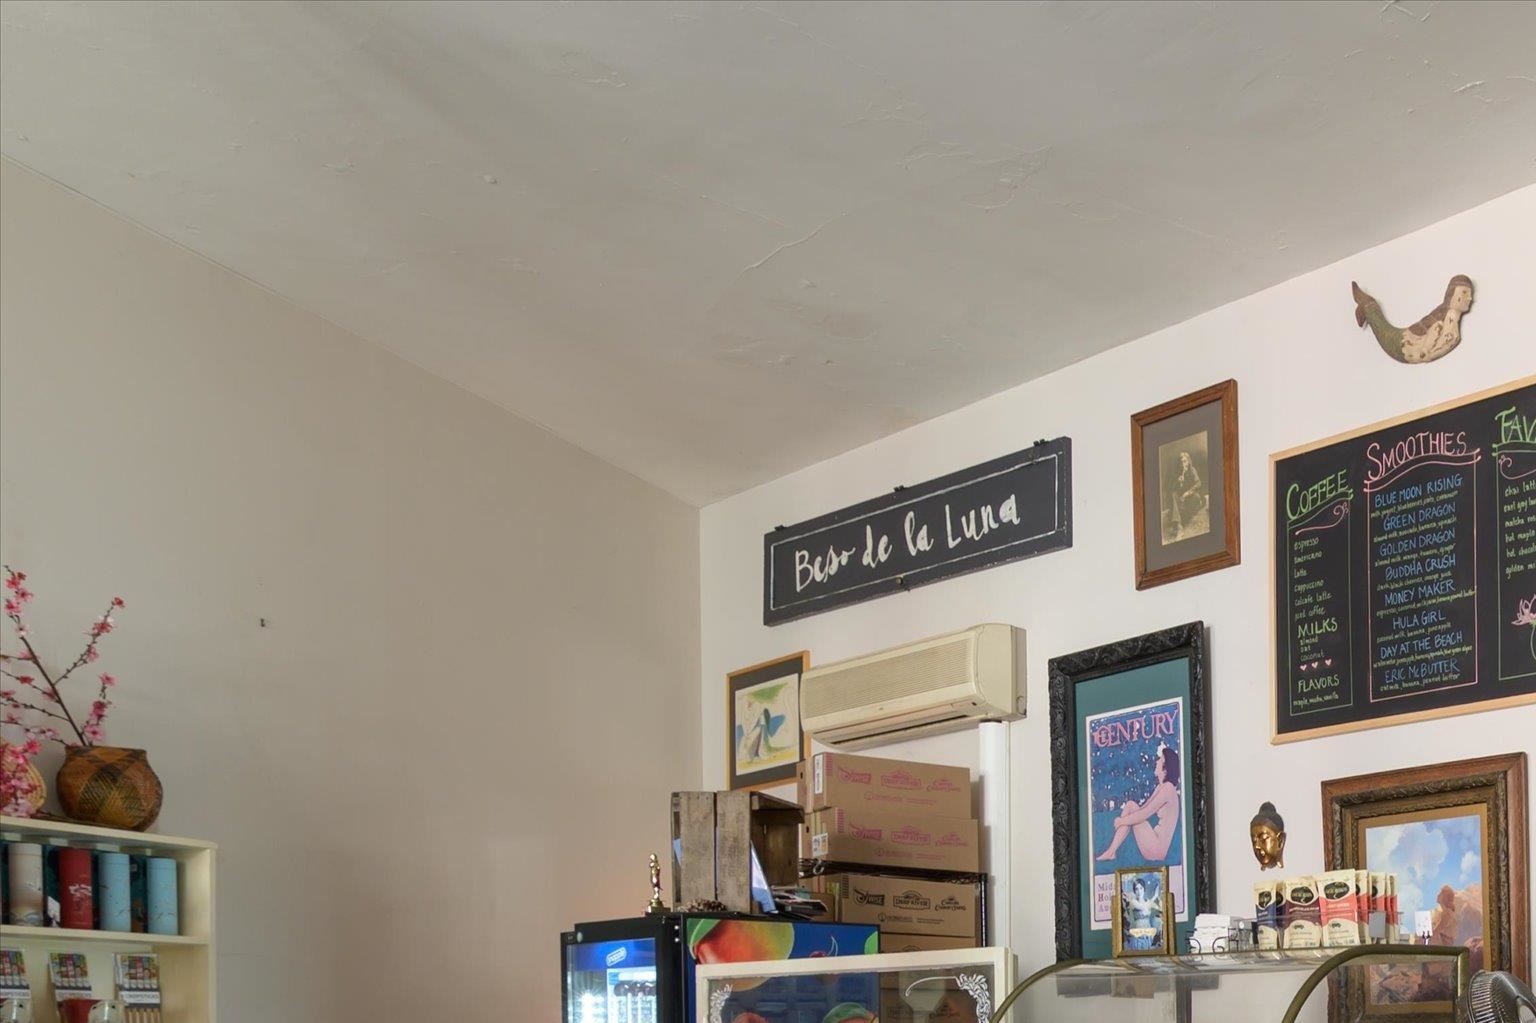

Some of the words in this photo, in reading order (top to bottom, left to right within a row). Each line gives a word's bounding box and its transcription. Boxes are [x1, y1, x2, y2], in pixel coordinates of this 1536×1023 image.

[1367, 431, 1467, 480] SMOOTHIES
[1286, 468, 1348, 520] COFFEE
[1375, 491, 1397, 508] BLUE
[1399, 484, 1422, 503] MOON
[1427, 473, 1463, 494] RISING
[1383, 513, 1416, 531] GREEN
[1419, 502, 1456, 521] DRAGON
[795, 547, 856, 592] Beso
[862, 525, 893, 568] de
[904, 511, 934, 556] la
[945, 494, 1021, 548] Luna
[1380, 539, 1417, 557] GOLDEN
[1419, 527, 1456, 548] DRAGON
[1505, 532, 1515, 543] hot
[1518, 529, 1536, 541] maple
[1385, 560, 1423, 581] BUDDHA
[1425, 553, 1456, 573] CRUSH
[1506, 547, 1516, 558] hot
[1384, 587, 1415, 607] MONEY
[1419, 578, 1456, 599] MAKER
[1298, 617, 1338, 639] MILKS
[1393, 614, 1420, 630] HULA
[1421, 609, 1447, 626] GIRL
[1380, 645, 1398, 660] DAY
[1399, 641, 1410, 655] AT
[1412, 636, 1432, 652] THE
[1434, 630, 1463, 648] BEACH
[1298, 674, 1340, 693] FLAVORS
[1385, 667, 1407, 684] ERIC
